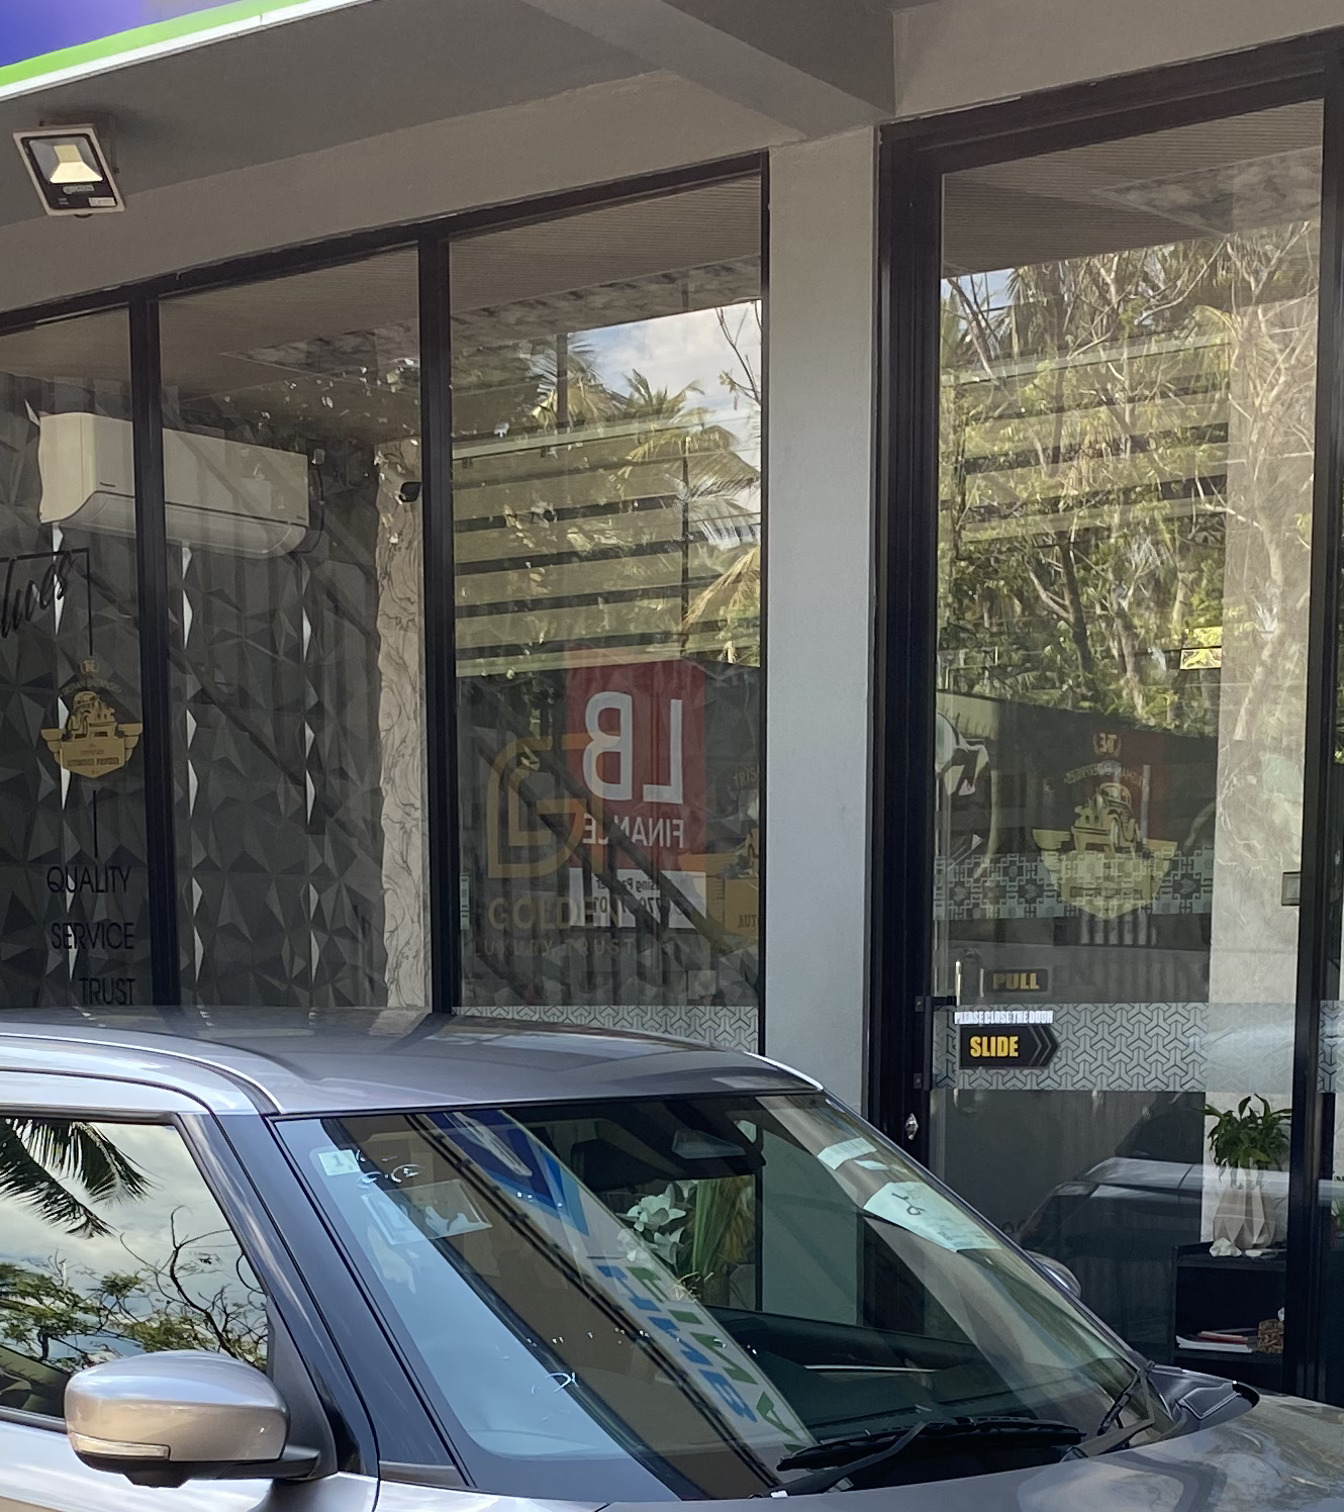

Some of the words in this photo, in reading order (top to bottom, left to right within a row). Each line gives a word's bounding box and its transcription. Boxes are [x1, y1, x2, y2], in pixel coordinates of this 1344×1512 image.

[46, 865, 132, 894] QUALITY
[50, 921, 135, 950] SERVICE
[77, 977, 137, 1006] TRUST
[992, 972, 1040, 990] PULL
[954, 1010, 984, 1025] PLEASE
[1012, 1010, 1029, 1024] THE
[969, 1035, 1019, 1057] SLIDE
